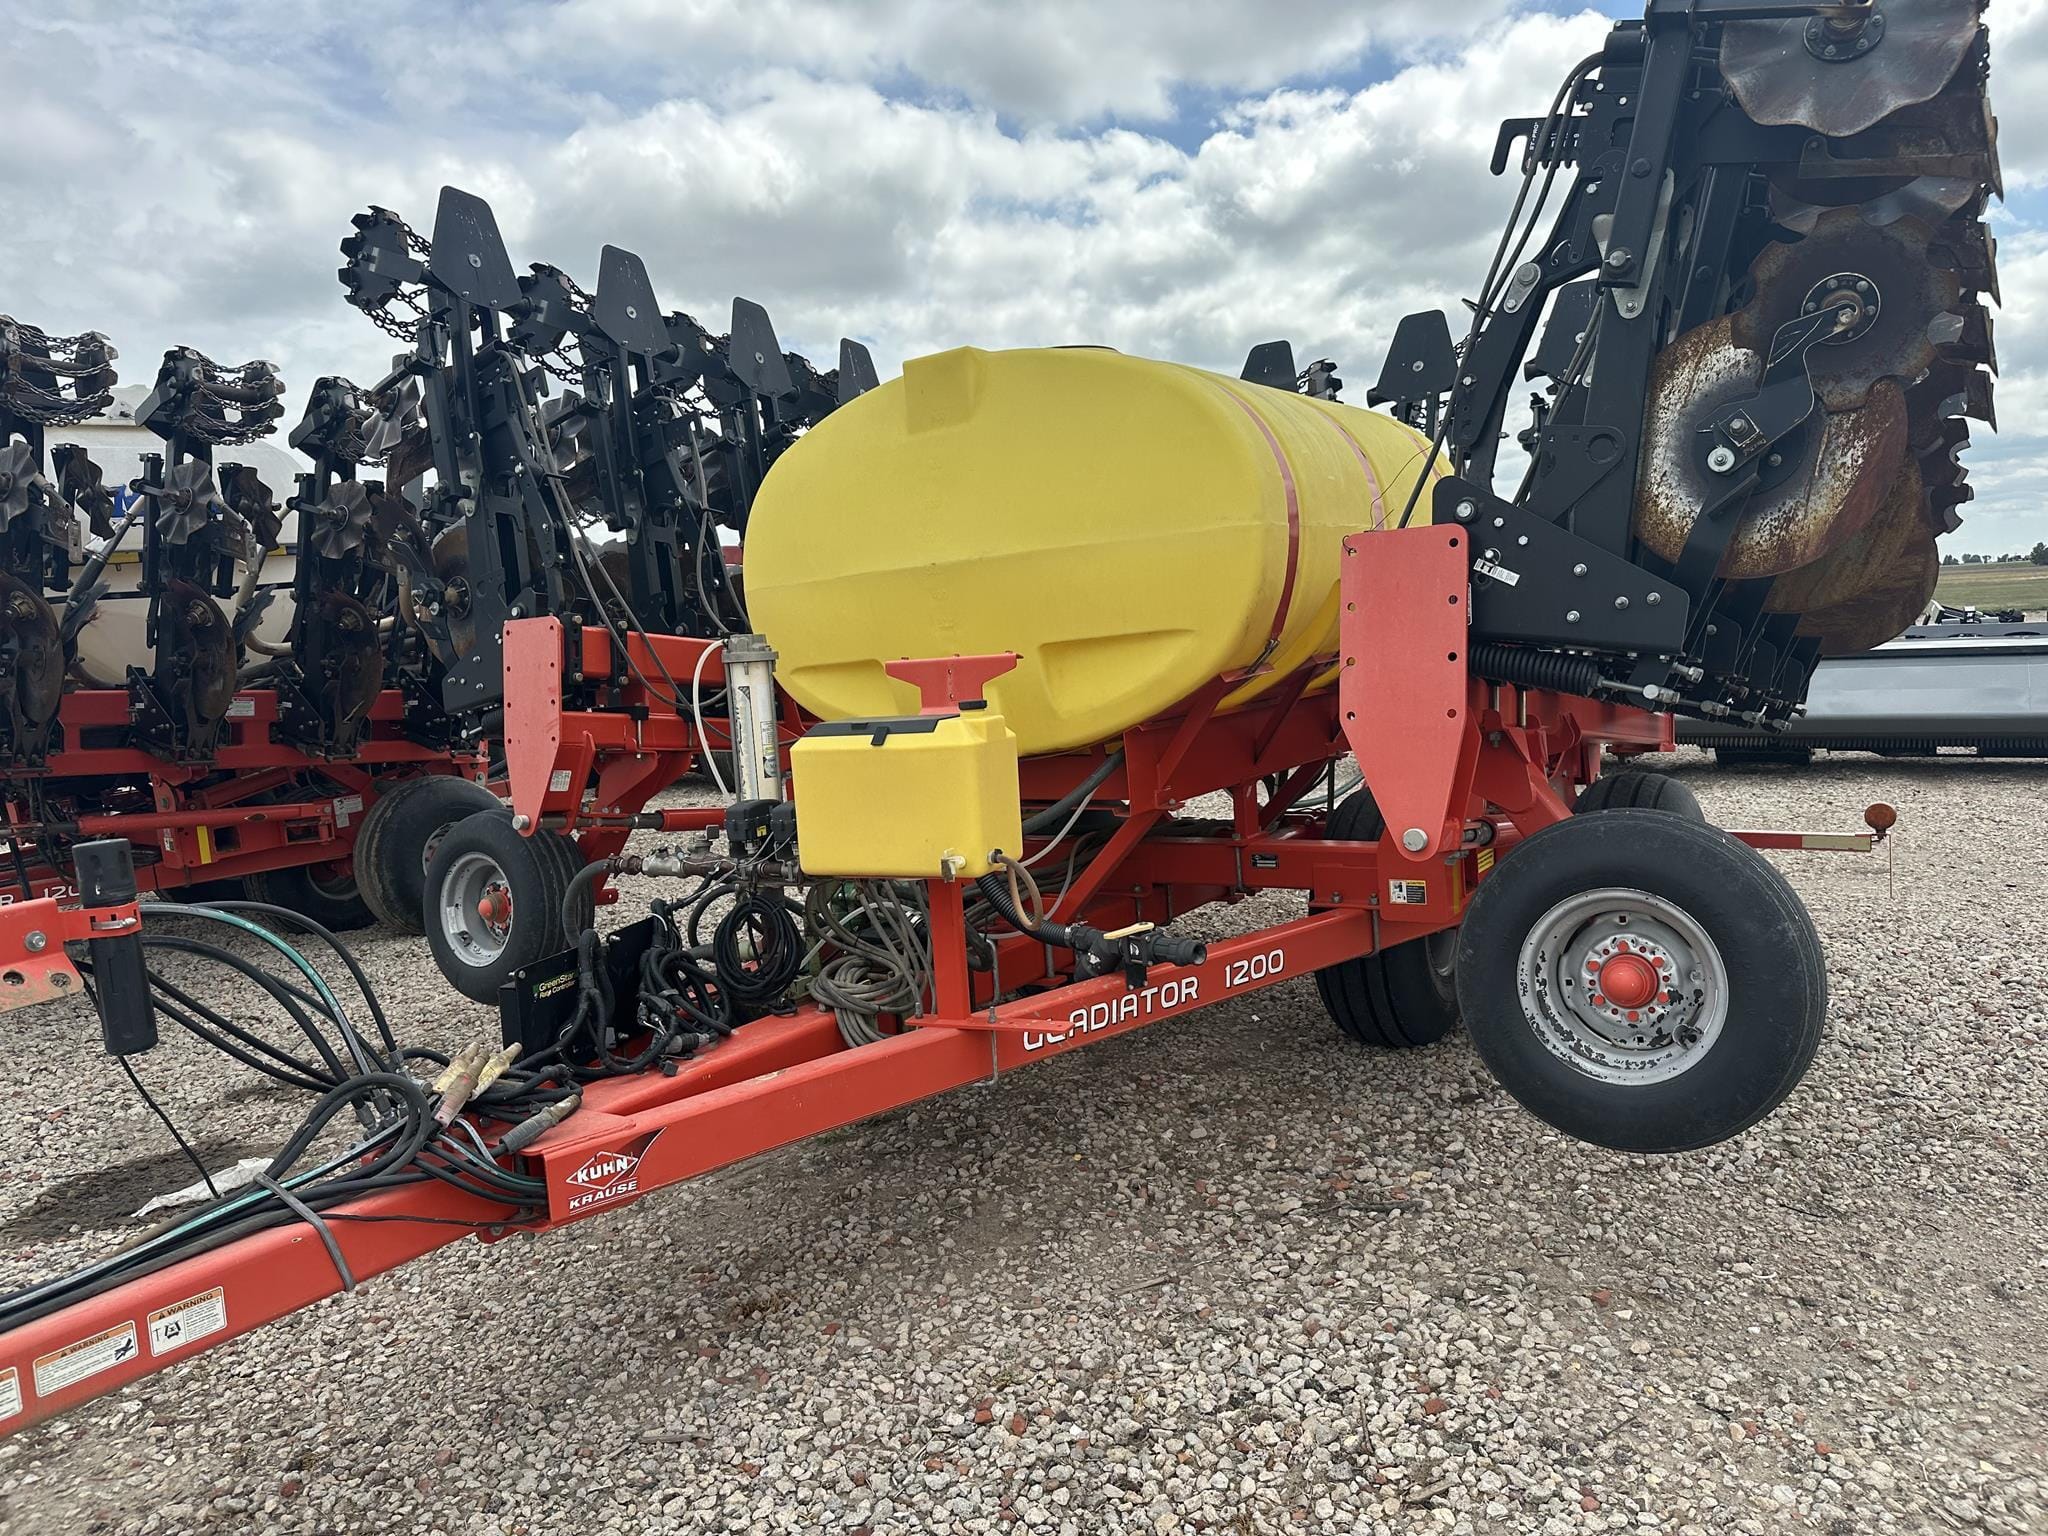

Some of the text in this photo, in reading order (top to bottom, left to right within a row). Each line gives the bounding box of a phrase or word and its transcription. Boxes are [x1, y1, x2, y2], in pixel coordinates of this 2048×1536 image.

[1225, 948, 1285, 989] 1200
[577, 1157, 628, 1184] KUHN
[569, 1180, 638, 1209] KRAUSE
[167, 1293, 214, 1316] WARNING
[70, 1333, 109, 1353] WARNING
